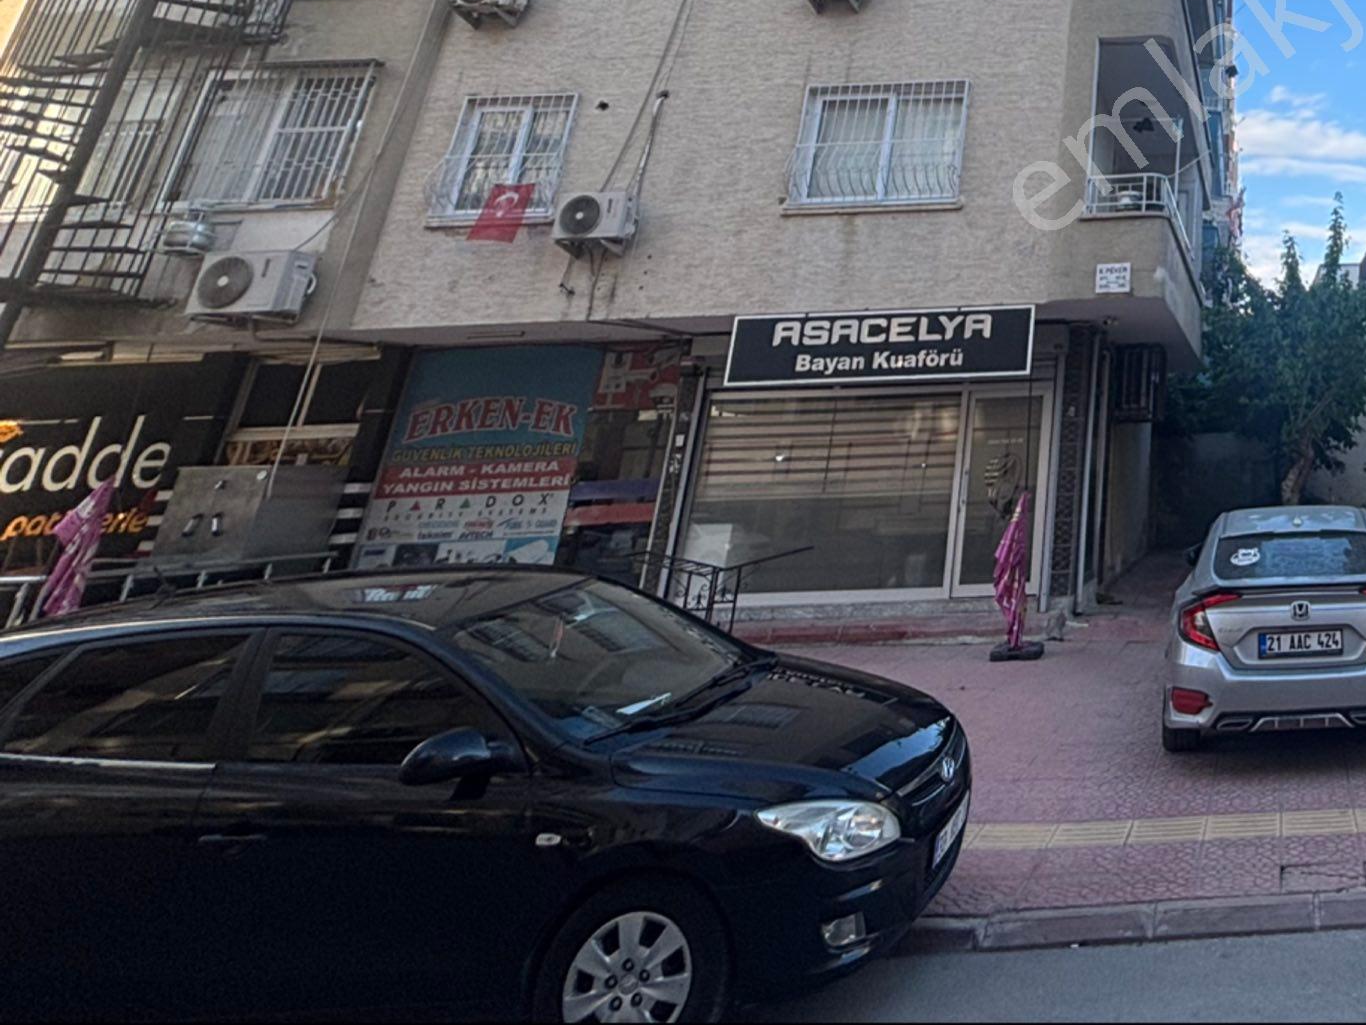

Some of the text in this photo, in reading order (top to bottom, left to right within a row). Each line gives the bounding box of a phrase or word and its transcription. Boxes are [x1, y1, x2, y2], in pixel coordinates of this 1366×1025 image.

[772, 313, 992, 347] ASACELYA
[795, 348, 964, 375] Bayan Kuaförü
[402, 396, 577, 443] ERKEN-EK
[0, 415, 171, 493] adde
[400, 465, 464, 478] ALARM
[481, 461, 559, 474] KAMERA
[383, 474, 570, 494] YANGIN SİSTEMLERİ
[1266, 633, 1339, 652] 21 AAC 424
